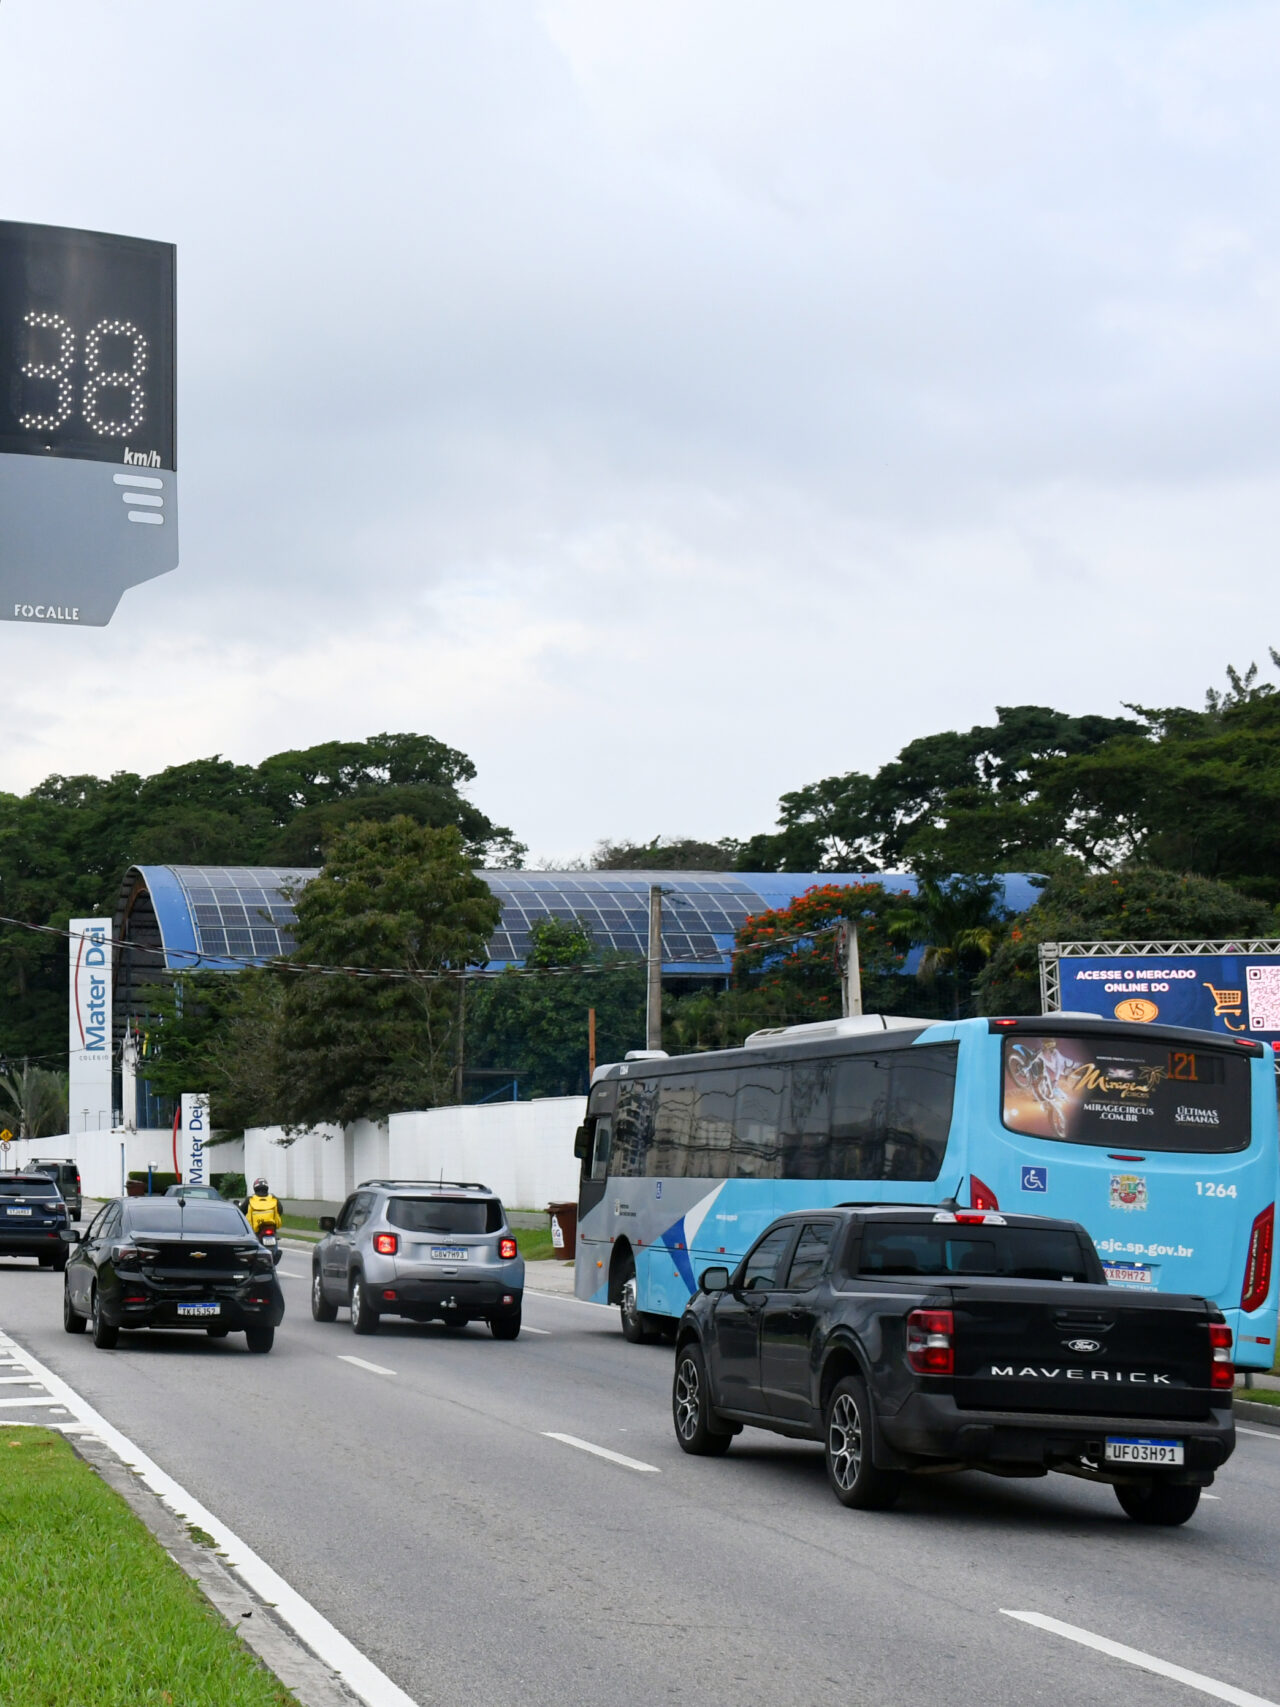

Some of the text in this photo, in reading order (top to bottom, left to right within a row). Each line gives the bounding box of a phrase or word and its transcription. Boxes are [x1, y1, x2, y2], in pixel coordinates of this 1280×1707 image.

[19, 312, 148, 437] 38
[123, 446, 162, 468] km/h
[14, 603, 80, 621] FOCALLE
[1076, 969, 1197, 980] ACESSE O MERCADO
[85, 926, 105, 1051] Mater Dei
[1104, 982, 1170, 993] ONLINE DO
[1083, 1103, 1155, 1116] MIRAGECIRCUS
[1099, 1112, 1138, 1123] .COM.BR
[1177, 1105, 1218, 1117] ÚLTIMAS
[1175, 1114, 1220, 1125] SEMANAS
[189, 1105, 203, 1184] Mater Dei
[1195, 1181, 1238, 1199] 1264
[991, 1366, 1171, 1384] MAVERICK
